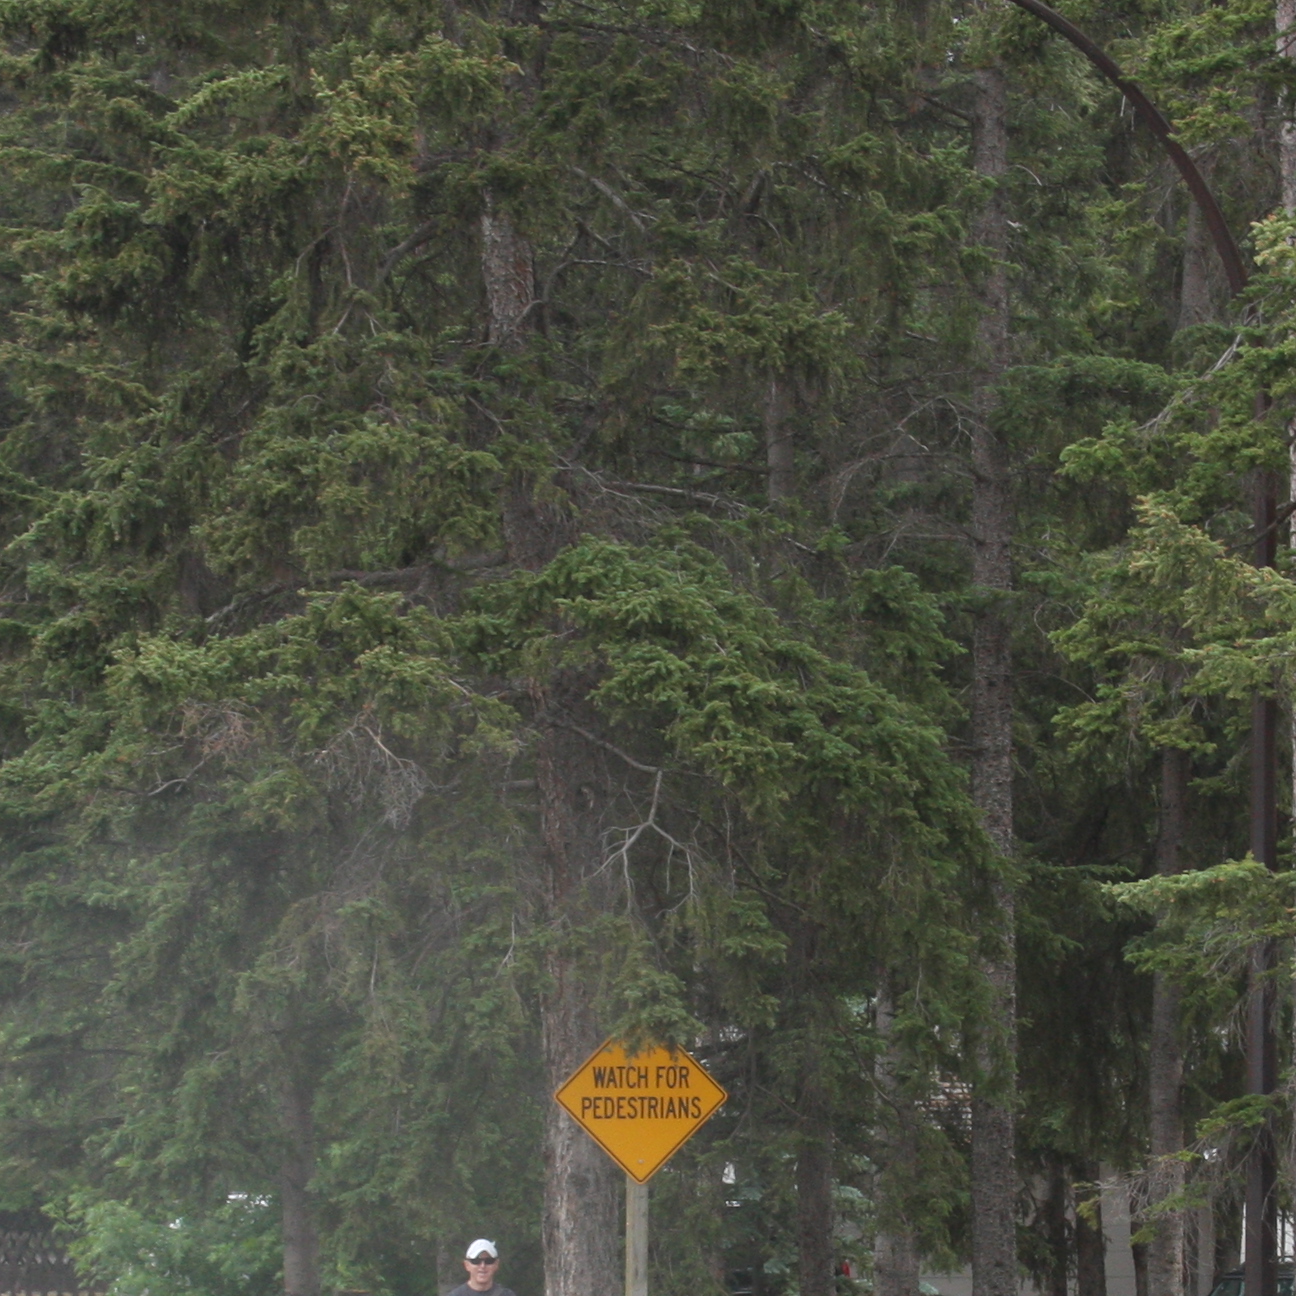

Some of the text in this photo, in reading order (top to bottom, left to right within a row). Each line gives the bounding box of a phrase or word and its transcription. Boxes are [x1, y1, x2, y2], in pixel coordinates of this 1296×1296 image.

[592, 1066, 690, 1089] WATCH FOR
[581, 1097, 702, 1119] PEDESTRIANS
